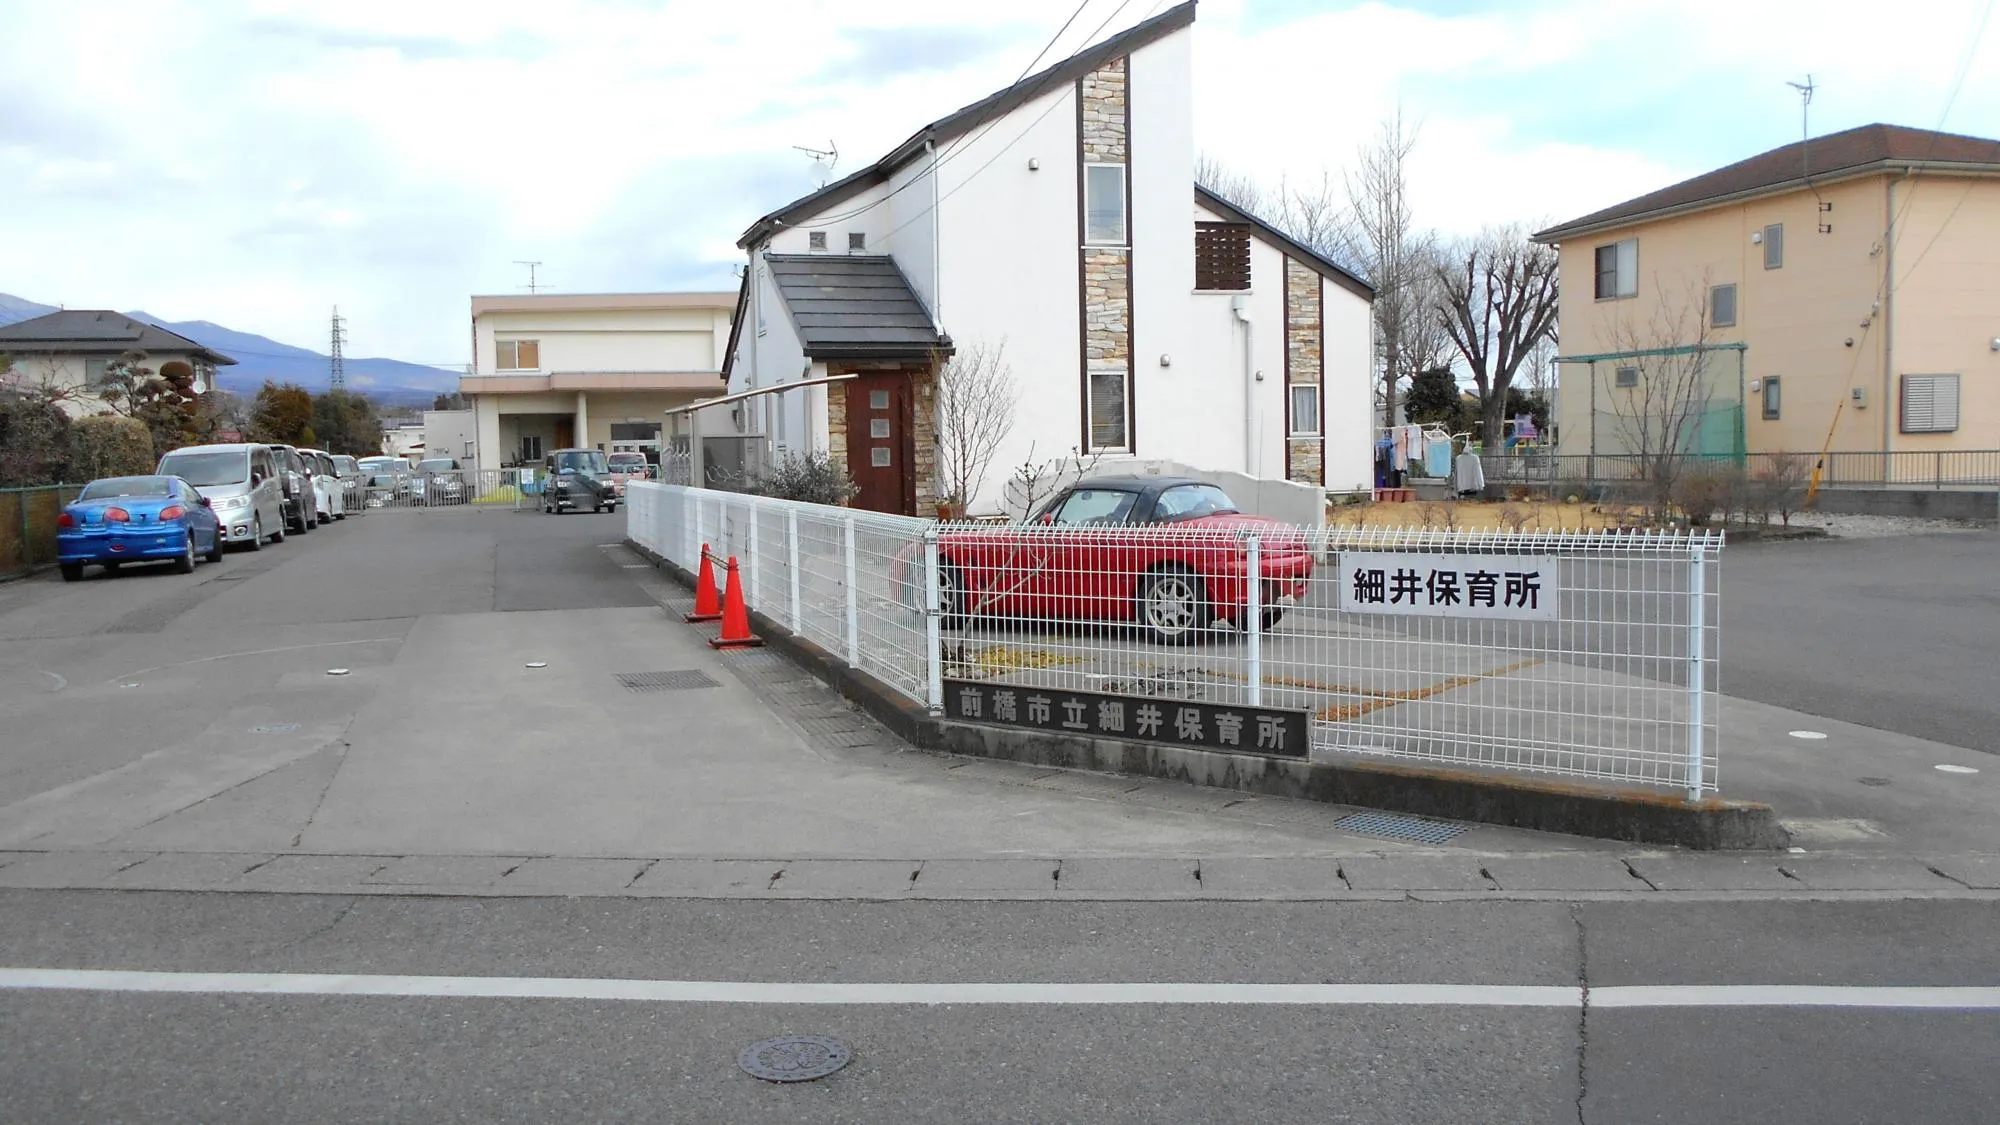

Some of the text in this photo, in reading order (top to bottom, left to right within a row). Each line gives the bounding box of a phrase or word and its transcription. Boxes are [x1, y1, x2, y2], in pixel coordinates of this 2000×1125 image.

[1353, 567, 1541, 609] 細井保育所
[959, 687, 1287, 750] 前橋市立細井保育所
